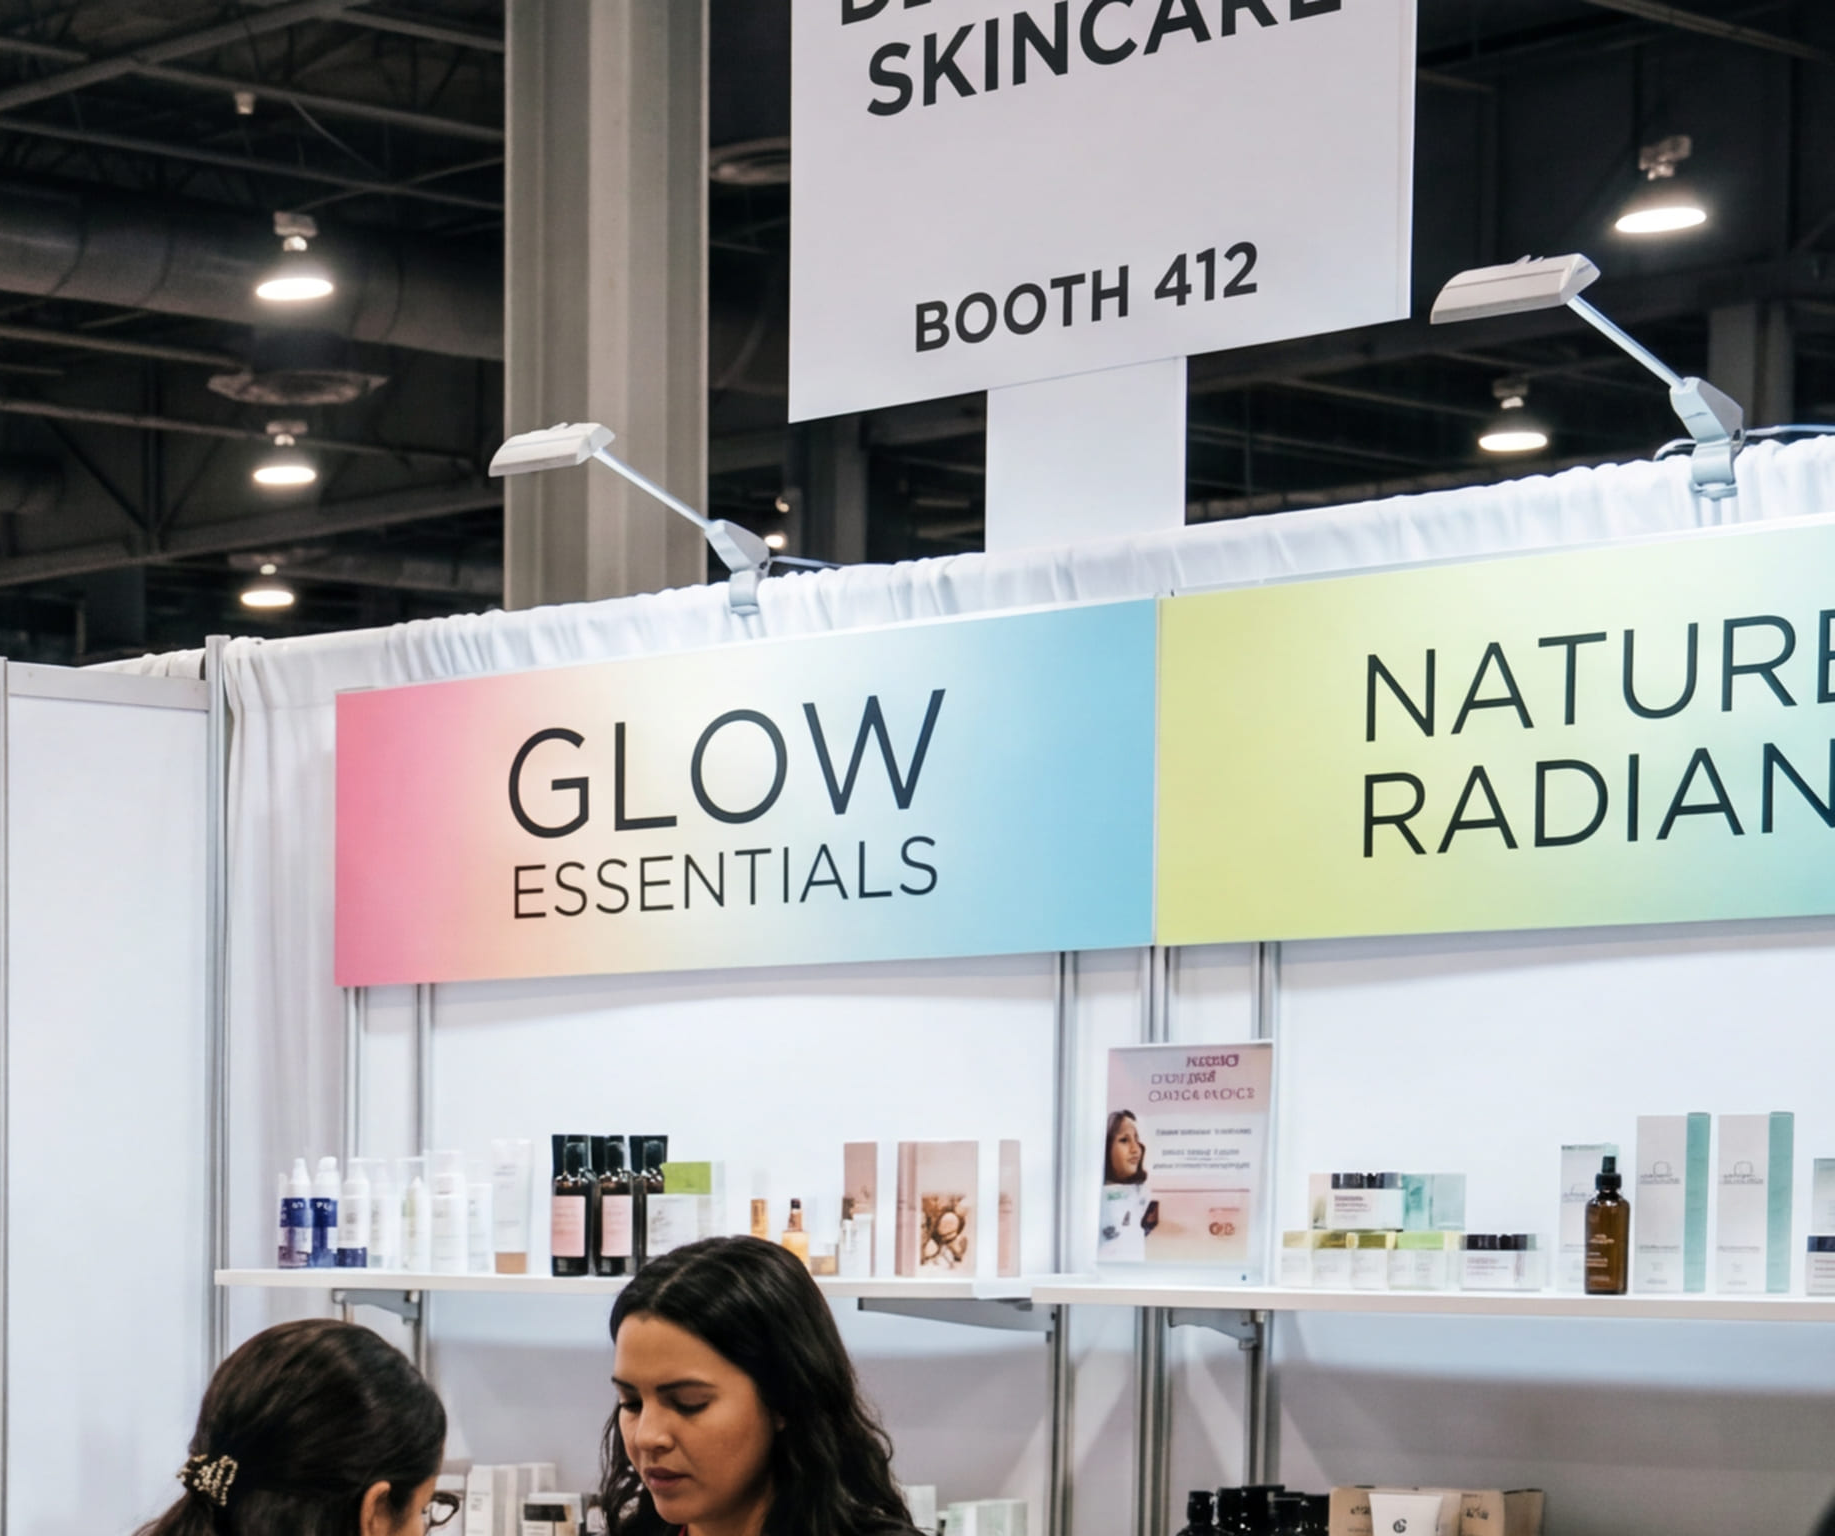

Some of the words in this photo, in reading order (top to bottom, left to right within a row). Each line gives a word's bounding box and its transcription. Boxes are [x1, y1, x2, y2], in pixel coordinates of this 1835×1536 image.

[866, 0, 1343, 116] SKINCA
[915, 264, 1130, 353] BOOTH
[1153, 240, 1259, 307] 412
[1365, 609, 1835, 742] NATUR
[508, 688, 946, 839] GLOW
[513, 836, 939, 919] ESSENTIALS
